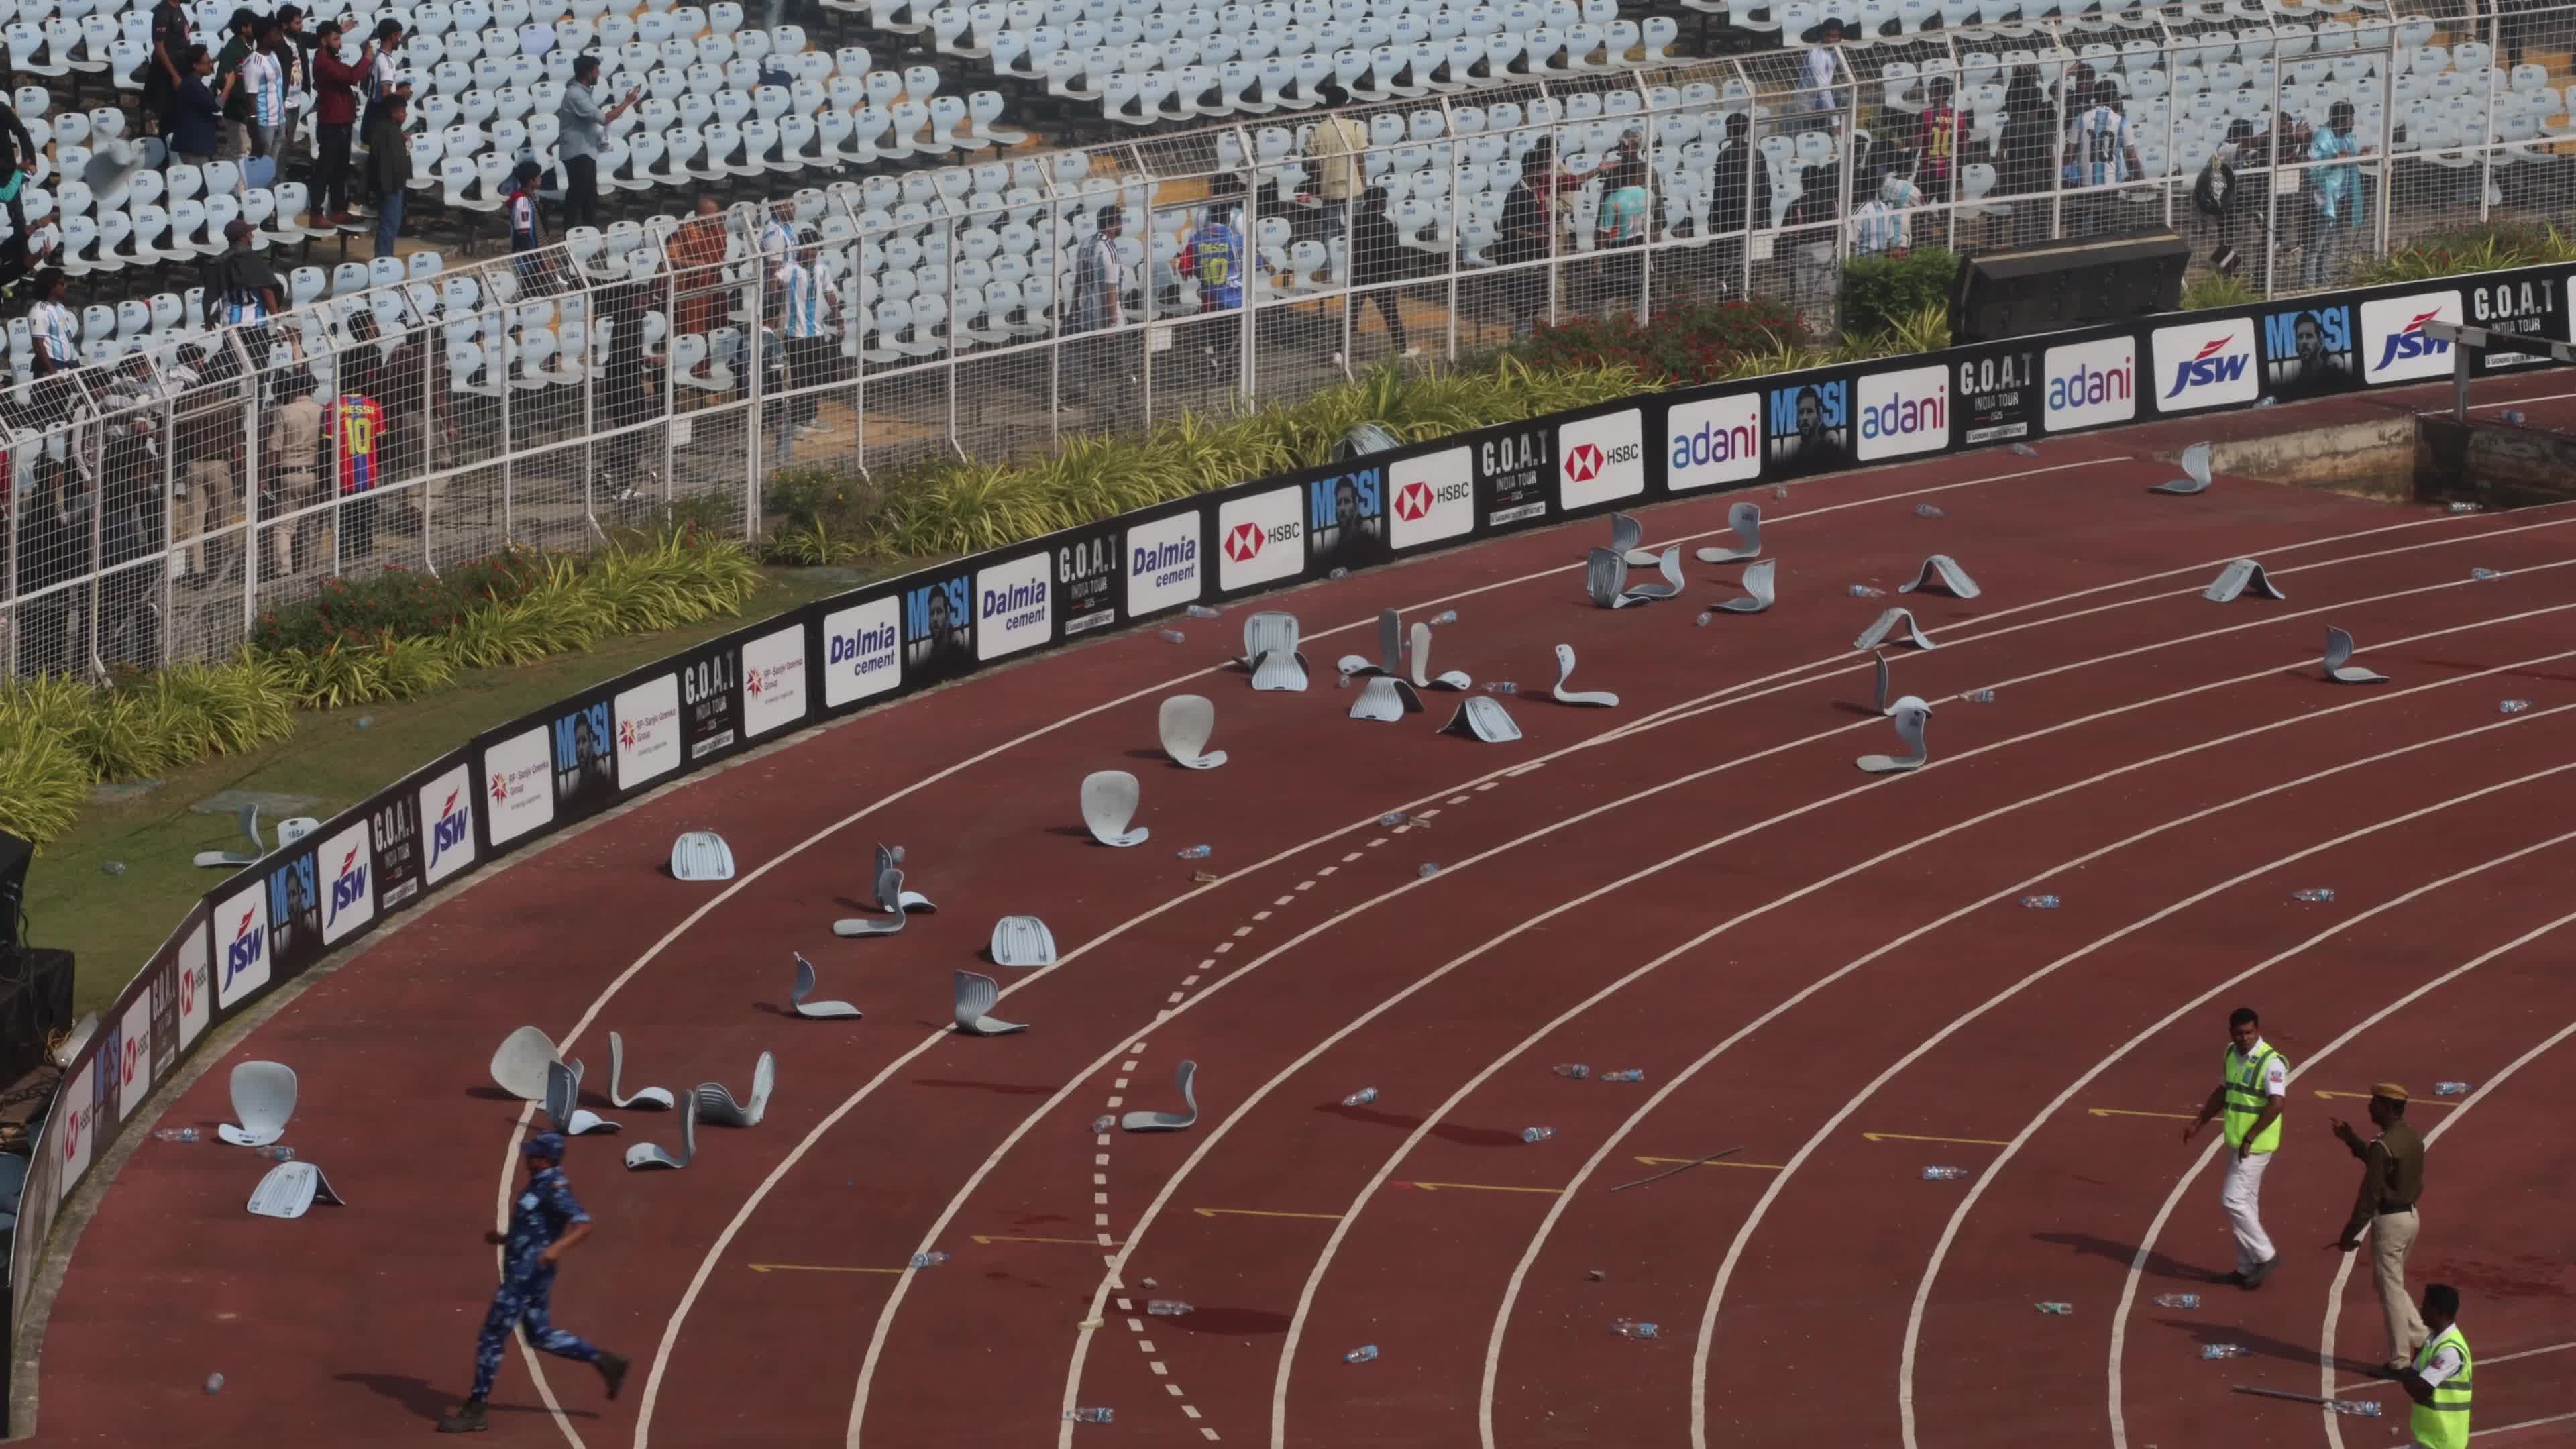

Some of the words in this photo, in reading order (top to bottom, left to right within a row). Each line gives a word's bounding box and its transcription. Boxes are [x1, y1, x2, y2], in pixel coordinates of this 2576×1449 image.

[2086, 129, 2115, 163] 10
[1202, 258, 1228, 285] 10
[2474, 279, 2554, 321] G.O.A.T
[2491, 321, 2515, 333] INDIA
[2518, 318, 2541, 333] TOUR
[1960, 353, 2033, 395] G.O.A.T
[2049, 356, 2131, 411] adani
[2164, 354, 2249, 399] JSW
[1862, 386, 1944, 439] adani
[1975, 396, 1995, 411] INDIA
[1998, 392, 2018, 407] TOUR
[345, 418, 372, 455] 10
[1483, 429, 1547, 476] G.O.A.T
[1607, 444, 1638, 465] HSBC
[1672, 413, 1756, 468] adani
[1437, 482, 1469, 504] HSBC
[1519, 471, 1536, 487] TOUR
[1268, 522, 1299, 544] HSBC
[1132, 535, 1195, 576] Dalmia
[1156, 563, 1194, 587] cement
[983, 578, 1045, 618] Dalmia
[1006, 607, 1044, 631] cement
[830, 623, 895, 664] Dalmia
[855, 652, 894, 676] cement
[429, 806, 468, 869] JSW
[327, 863, 367, 929] JSW
[223, 924, 264, 993] JSW
